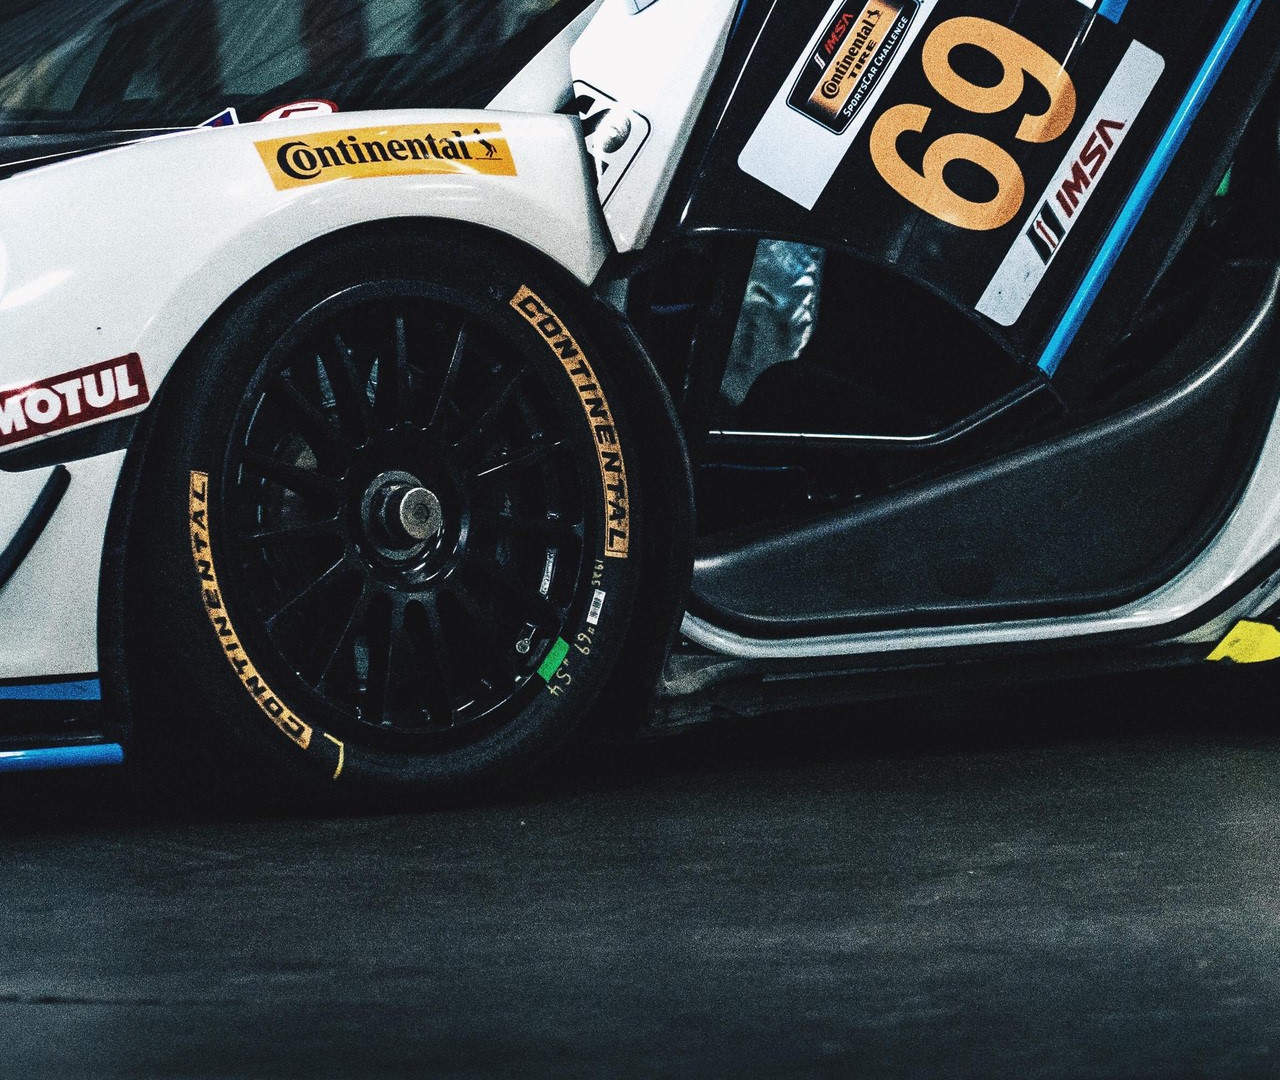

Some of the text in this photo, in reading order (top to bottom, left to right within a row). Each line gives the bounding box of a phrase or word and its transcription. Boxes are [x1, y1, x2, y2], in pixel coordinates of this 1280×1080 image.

[821, 19, 876, 99] Continental
[824, 13, 854, 54] IMSA
[848, 40, 877, 79] TIRE
[277, 130, 472, 180] Continental
[869, 15, 1077, 231] 69
[1055, 119, 1125, 218] IMSA
[517, 295, 627, 549] CONTINENTAL
[192, 481, 305, 738] CONTINENTAL
